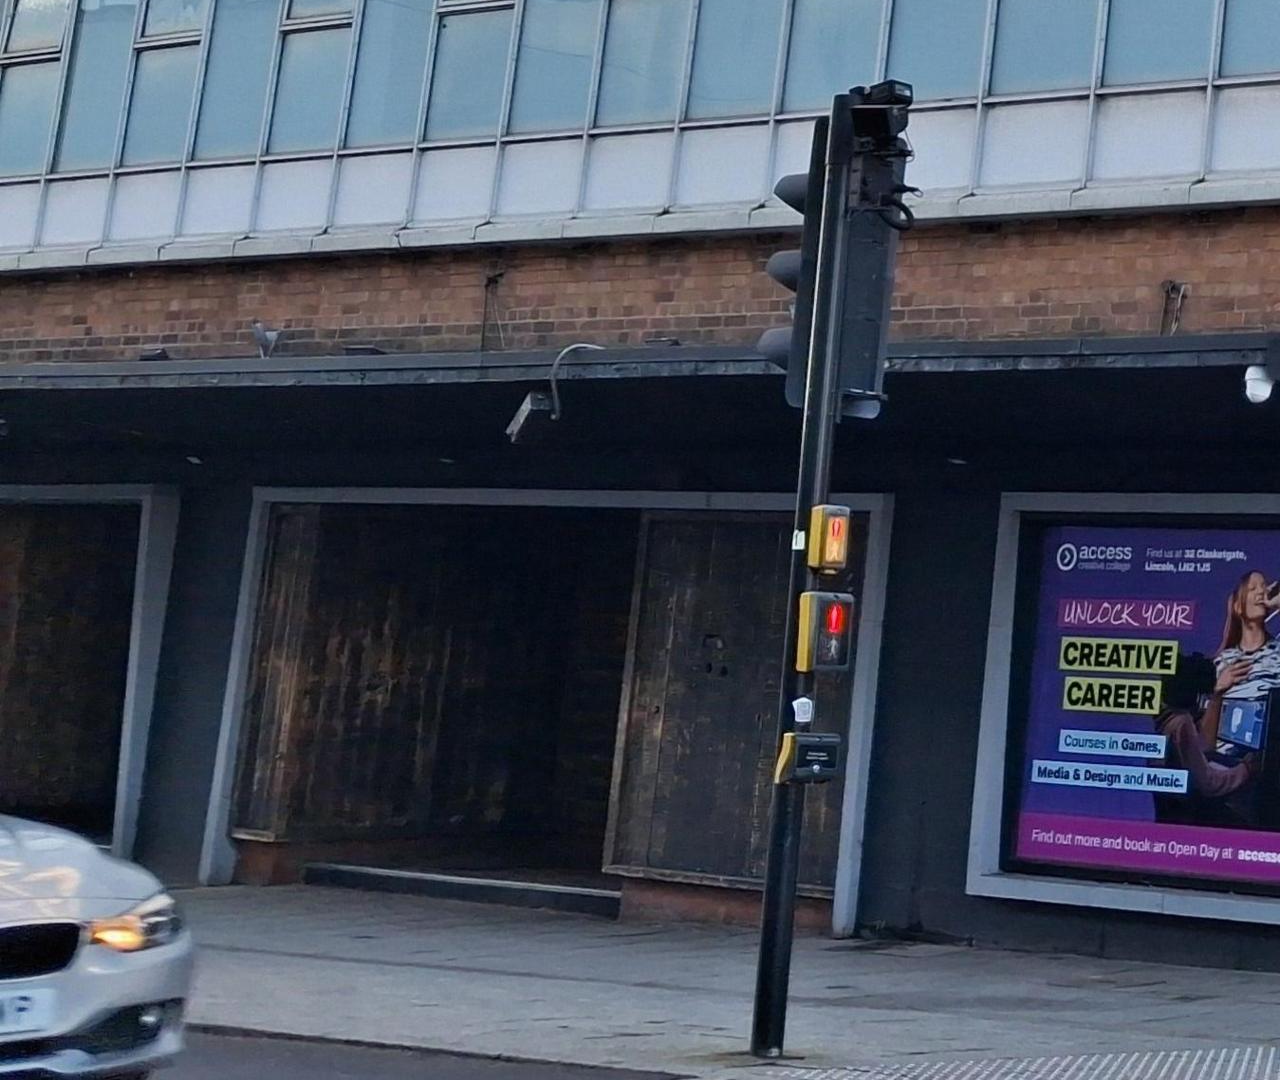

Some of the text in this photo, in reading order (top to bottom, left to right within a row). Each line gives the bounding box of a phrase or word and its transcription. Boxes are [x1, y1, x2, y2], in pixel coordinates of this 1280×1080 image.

[1079, 545, 1133, 560] access
[1146, 548, 1163, 558] Find
[1064, 600, 1193, 627] UNLOCK YOUR
[1063, 642, 1173, 670] CREATIVE
[1066, 681, 1155, 710] CAREER
[1064, 735, 1161, 755] Courses in Games,
[1037, 766, 1183, 788] Media & Design and Music.
[1031, 829, 1054, 844] Find
[1055, 834, 1072, 845] out
[1074, 835, 1101, 847] more
[1102, 837, 1122, 849] and
[1124, 837, 1151, 852] book
[1152, 843, 1166, 853] an
[1168, 841, 1197, 857] Open
[1199, 843, 1220, 861] Day
[1222, 848, 1233, 859] at
